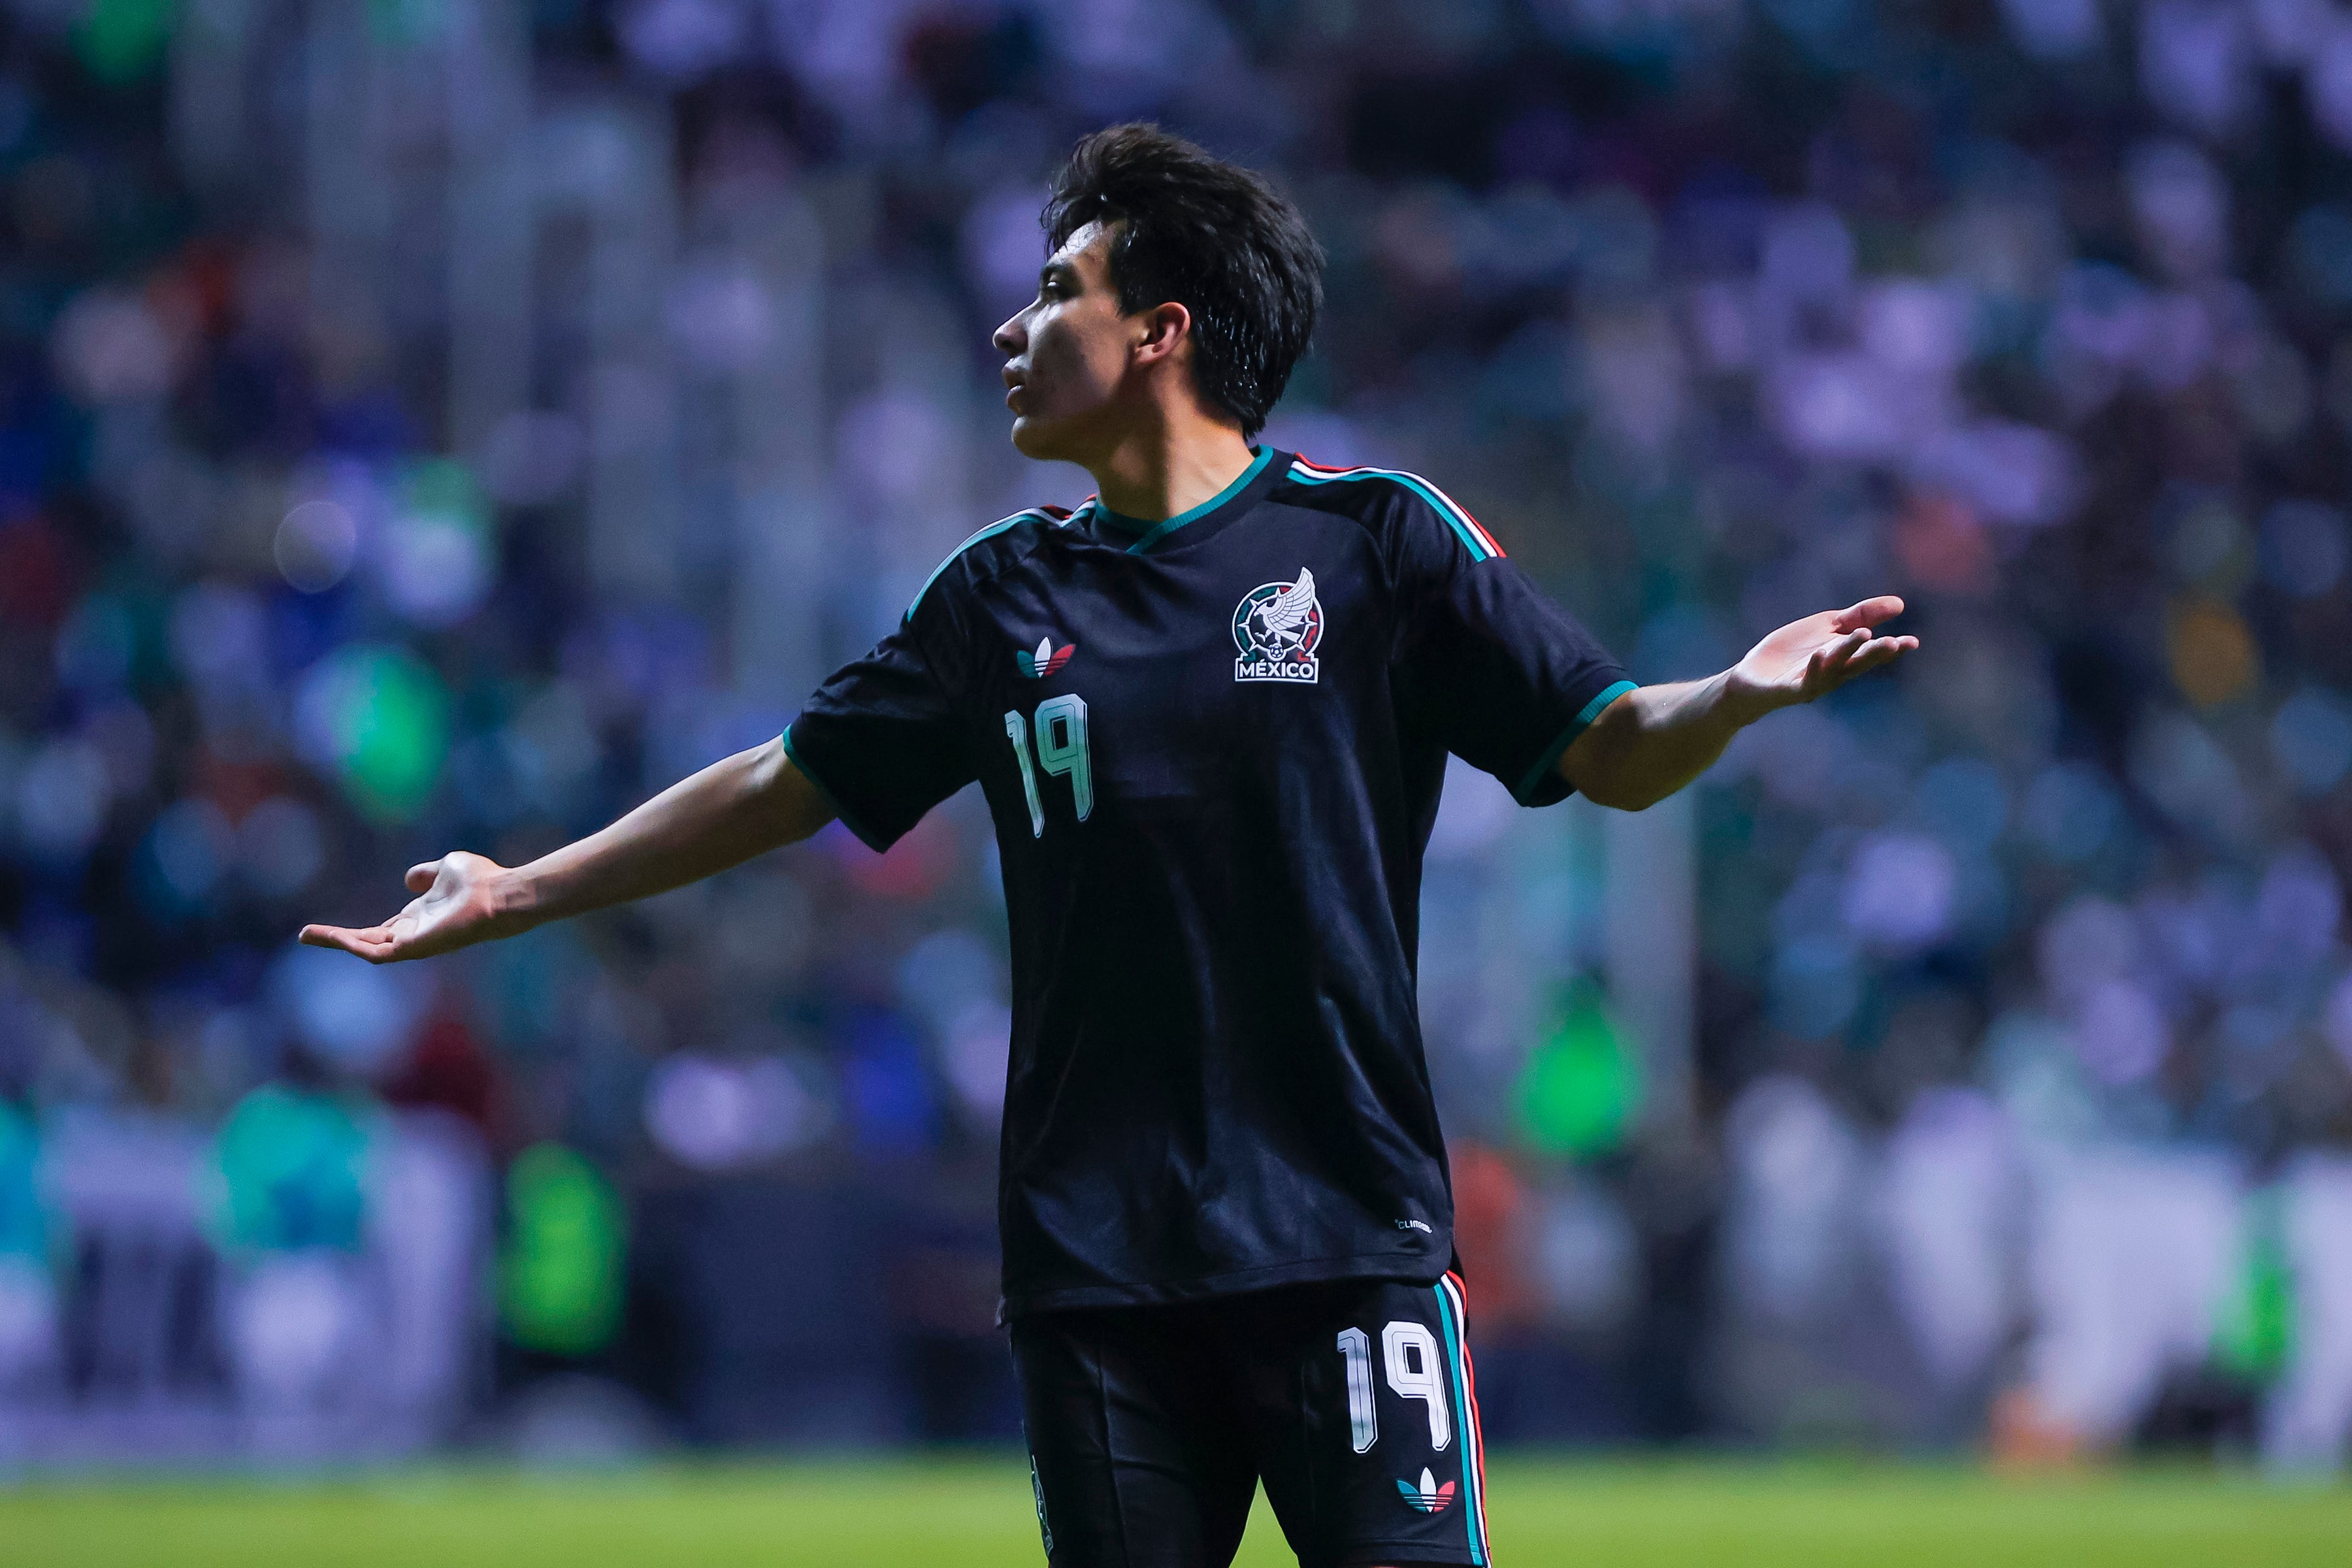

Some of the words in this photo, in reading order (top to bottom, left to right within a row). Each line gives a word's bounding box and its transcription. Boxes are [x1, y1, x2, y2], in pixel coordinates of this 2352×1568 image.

[1239, 659, 1314, 678] MÉXICO
[1004, 693, 1094, 838] 19
[1337, 1321, 1451, 1454] 19
